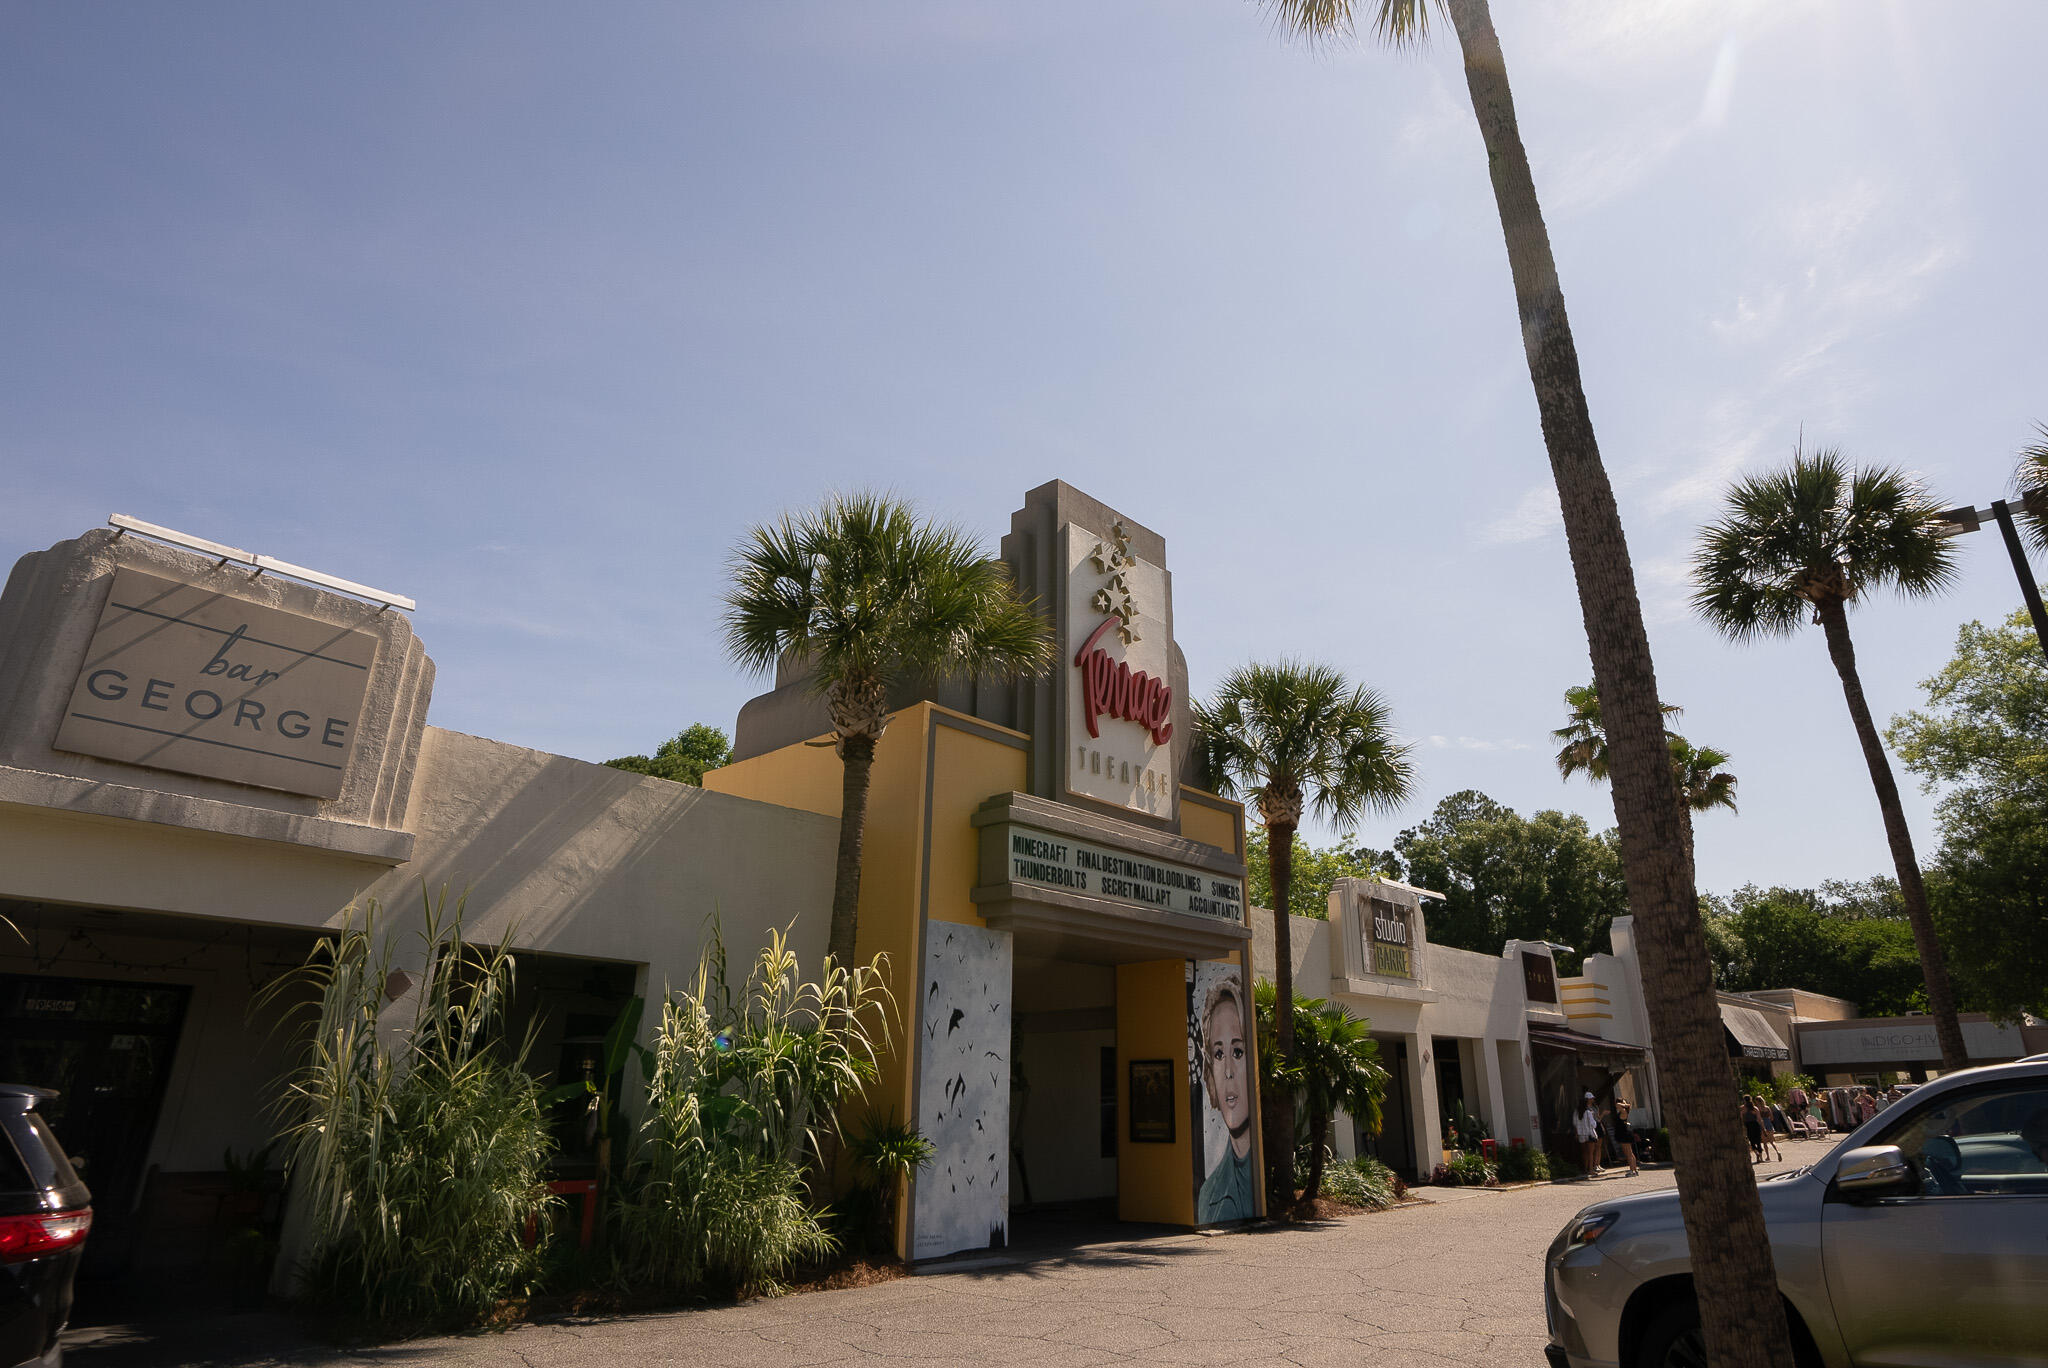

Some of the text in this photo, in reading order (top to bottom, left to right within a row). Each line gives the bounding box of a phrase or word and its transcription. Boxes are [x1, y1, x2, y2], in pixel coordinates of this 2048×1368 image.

[200, 623, 279, 687] bar
[1075, 616, 1174, 746] Terrace
[86, 668, 350, 749] GEORGE
[1079, 745, 1168, 796] THEATRE
[1012, 834, 1240, 901] MINECRAFT FINAL DESTINATION BLOODLINES SINNERS
[1013, 858, 1087, 890] THUNDERBOLTS
[1101, 876, 1133, 900] SECRET
[1132, 883, 1155, 904] MALL
[1154, 888, 1171, 907] APT
[1375, 902, 1407, 944] studio
[1377, 945, 1409, 974] BARRE
